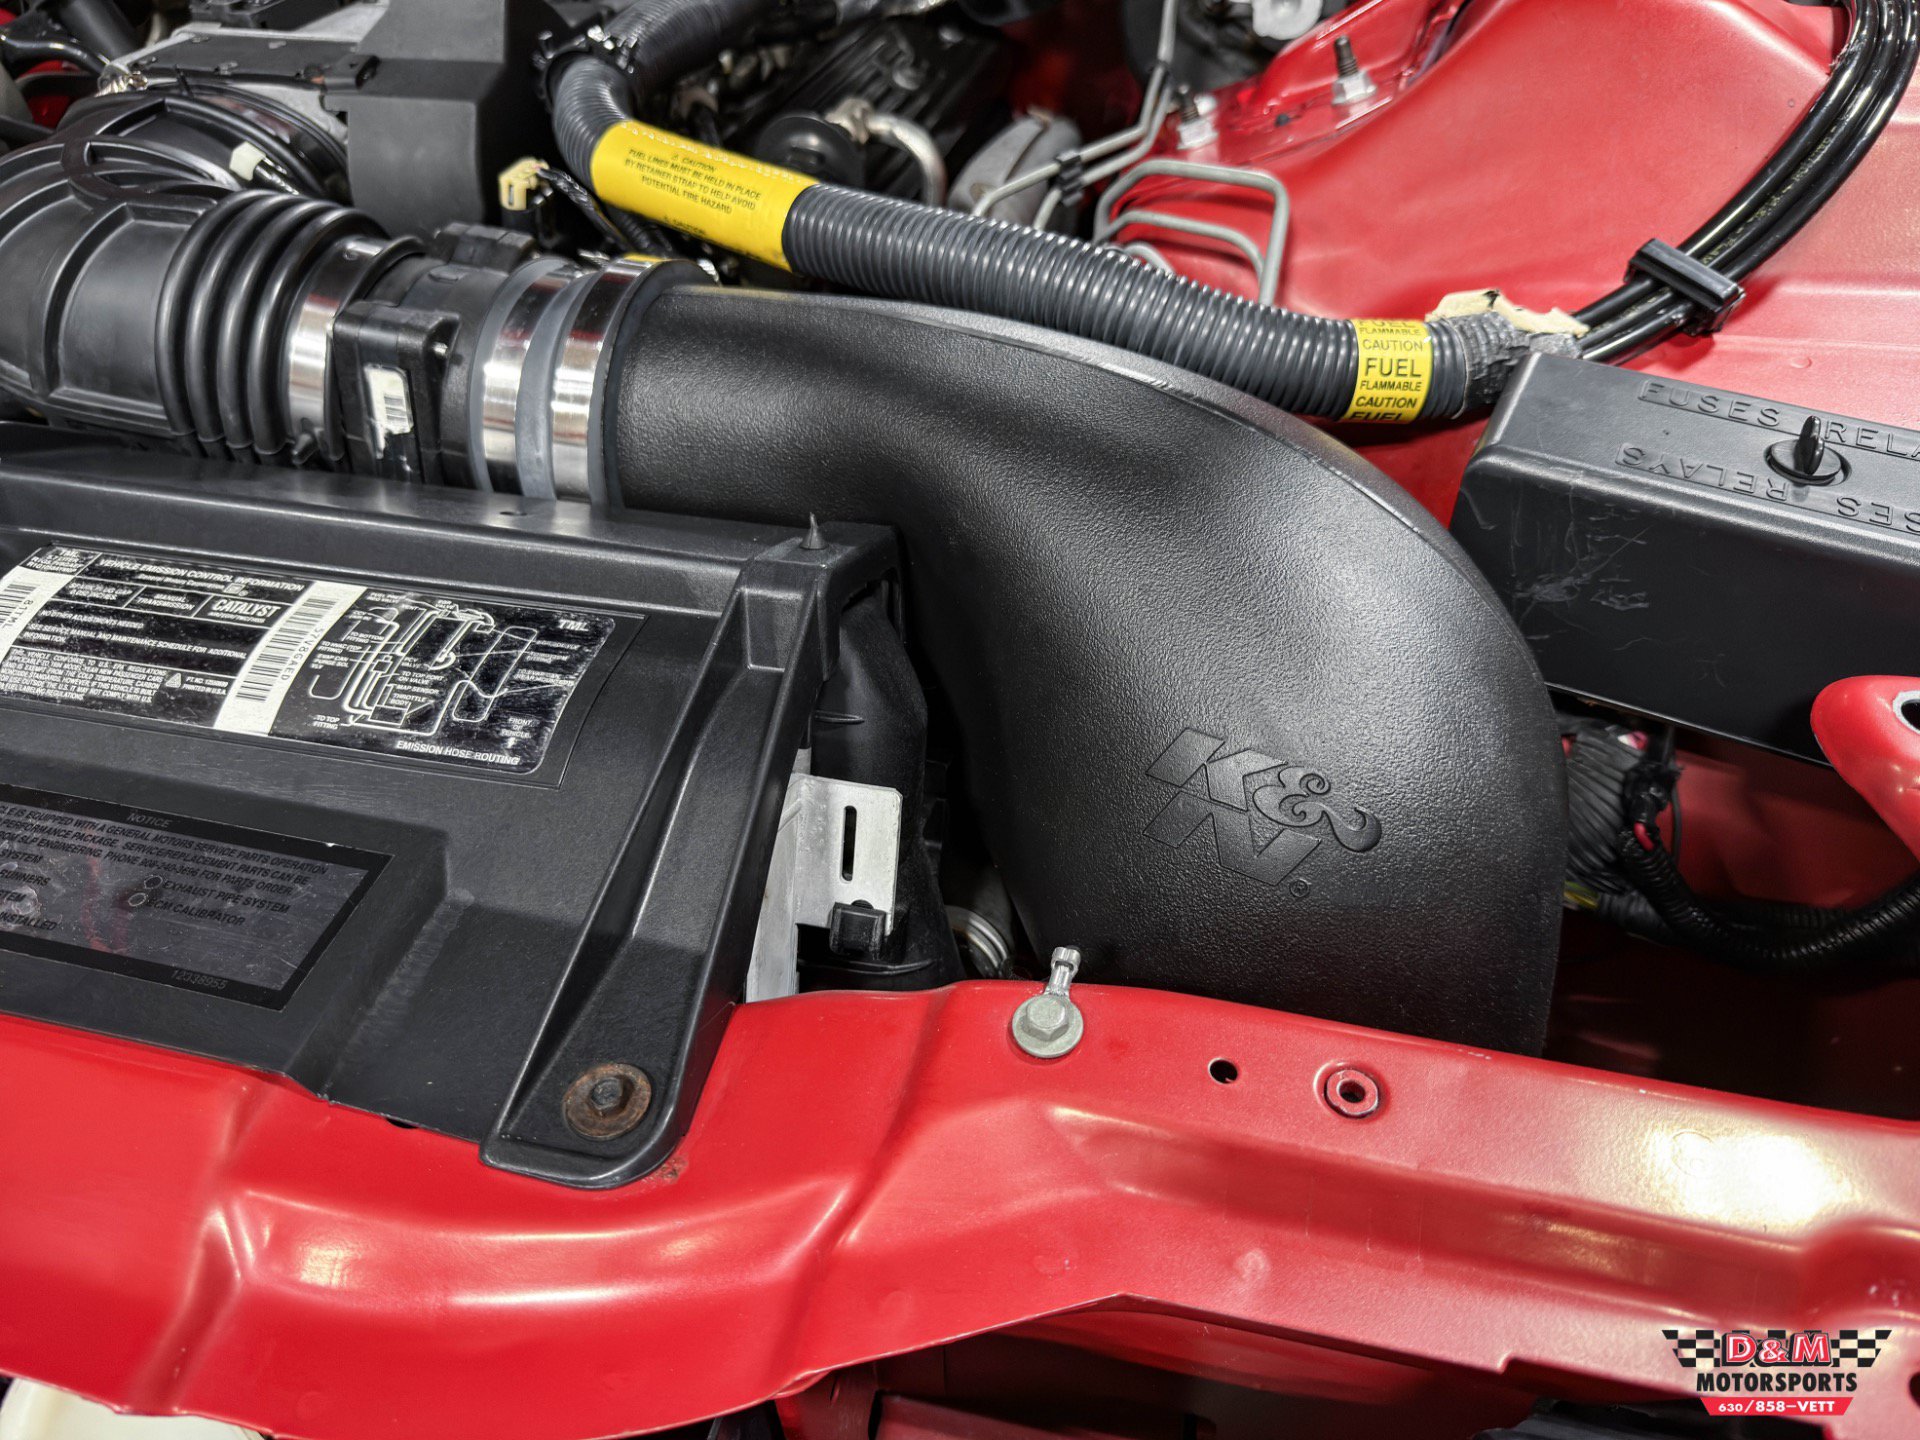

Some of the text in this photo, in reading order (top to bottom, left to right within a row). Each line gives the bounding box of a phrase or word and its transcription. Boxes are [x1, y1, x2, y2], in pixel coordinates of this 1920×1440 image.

[682, 157, 716, 173] CAUTION
[629, 149, 762, 201] FUEL LINES MUST BE HELD IN PLACE
[625, 158, 635, 168] BY
[636, 162, 672, 180] RETAINER
[699, 184, 709, 194] TO
[731, 196, 756, 211] AVOID
[641, 175, 732, 215] POTENTIAL FIRE HAZARD
[1359, 328, 1422, 336] FLAMMABLE
[1362, 339, 1423, 351] CAUTION
[1365, 357, 1422, 378] FUEL
[1360, 380, 1422, 392] FLAMMABLE
[1356, 396, 1418, 409] CAUTION
[1639, 379, 1780, 428] FUSES
[1620, 446, 1788, 502] RELAYS
[97, 559, 140, 571] VEHICLE
[140, 565, 188, 577] EMISSION
[187, 570, 234, 583] CONTROL
[234, 577, 305, 592] INFORMATION
[137, 598, 196, 611] TRANSMISSION
[154, 594, 186, 603] MANUAL
[211, 599, 282, 618] CATALYST
[559, 619, 589, 632] TML
[42, 624, 70, 634] SERVICE
[70, 628, 96, 638] MANUAL
[96, 632, 112, 640] AND
[111, 634, 158, 646] MAINTENANCE
[157, 641, 194, 652] SCHEDULE
[208, 648, 247, 660] ADDITIONAL
[346, 636, 370, 644] FITTING
[99, 668, 113, 676] NEW
[113, 670, 147, 681] PASSENGER
[147, 675, 164, 684] CARS
[127, 664, 168, 677] REGULATIONS
[78, 672, 94, 680] COLD
[94, 674, 136, 686] TEMPERATURE
[136, 680, 161, 690] CARBON
[110, 684, 134, 693] VEHICLE
[89, 688, 102, 696] NOT
[392, 692, 428, 702] THROTTLE
[412, 686, 440, 694] SENSOR
[390, 698, 408, 706] BODY
[312, 721, 338, 730] FITTING
[508, 718, 533, 726] FRONT
[396, 741, 521, 766] EMISSION HOSE ROUTING
[127, 812, 172, 828] NOTICE
[18, 808, 26, 818] IS
[26, 810, 73, 826] EQUIPPED
[73, 819, 98, 830] WITH
[97, 823, 106, 832] A
[106, 825, 152, 841] GENERAL
[152, 834, 195, 850] MOTORS
[194, 841, 237, 857] SERVICE
[237, 850, 270, 864] PARTS
[270, 856, 328, 875] OPERATION
[0, 849, 44, 864] SYSTEM
[1, 819, 72, 840] PERFORMANCE
[122, 842, 165, 857] SERVICE
[164, 848, 238, 870] REPLACEMENT
[236, 863, 270, 878] PARTS
[270, 870, 294, 882] CAN
[294, 875, 311, 886] BE
[18, 834, 39, 845] SLP
[104, 850, 140, 865] PHONE
[200, 869, 222, 880] FOR
[222, 874, 256, 888] PARTS
[0, 868, 52, 886] RUNNERS
[162, 880, 292, 914] EXHAUST PIPE SYSTEM
[172, 903, 247, 926] CALIBRATOR
